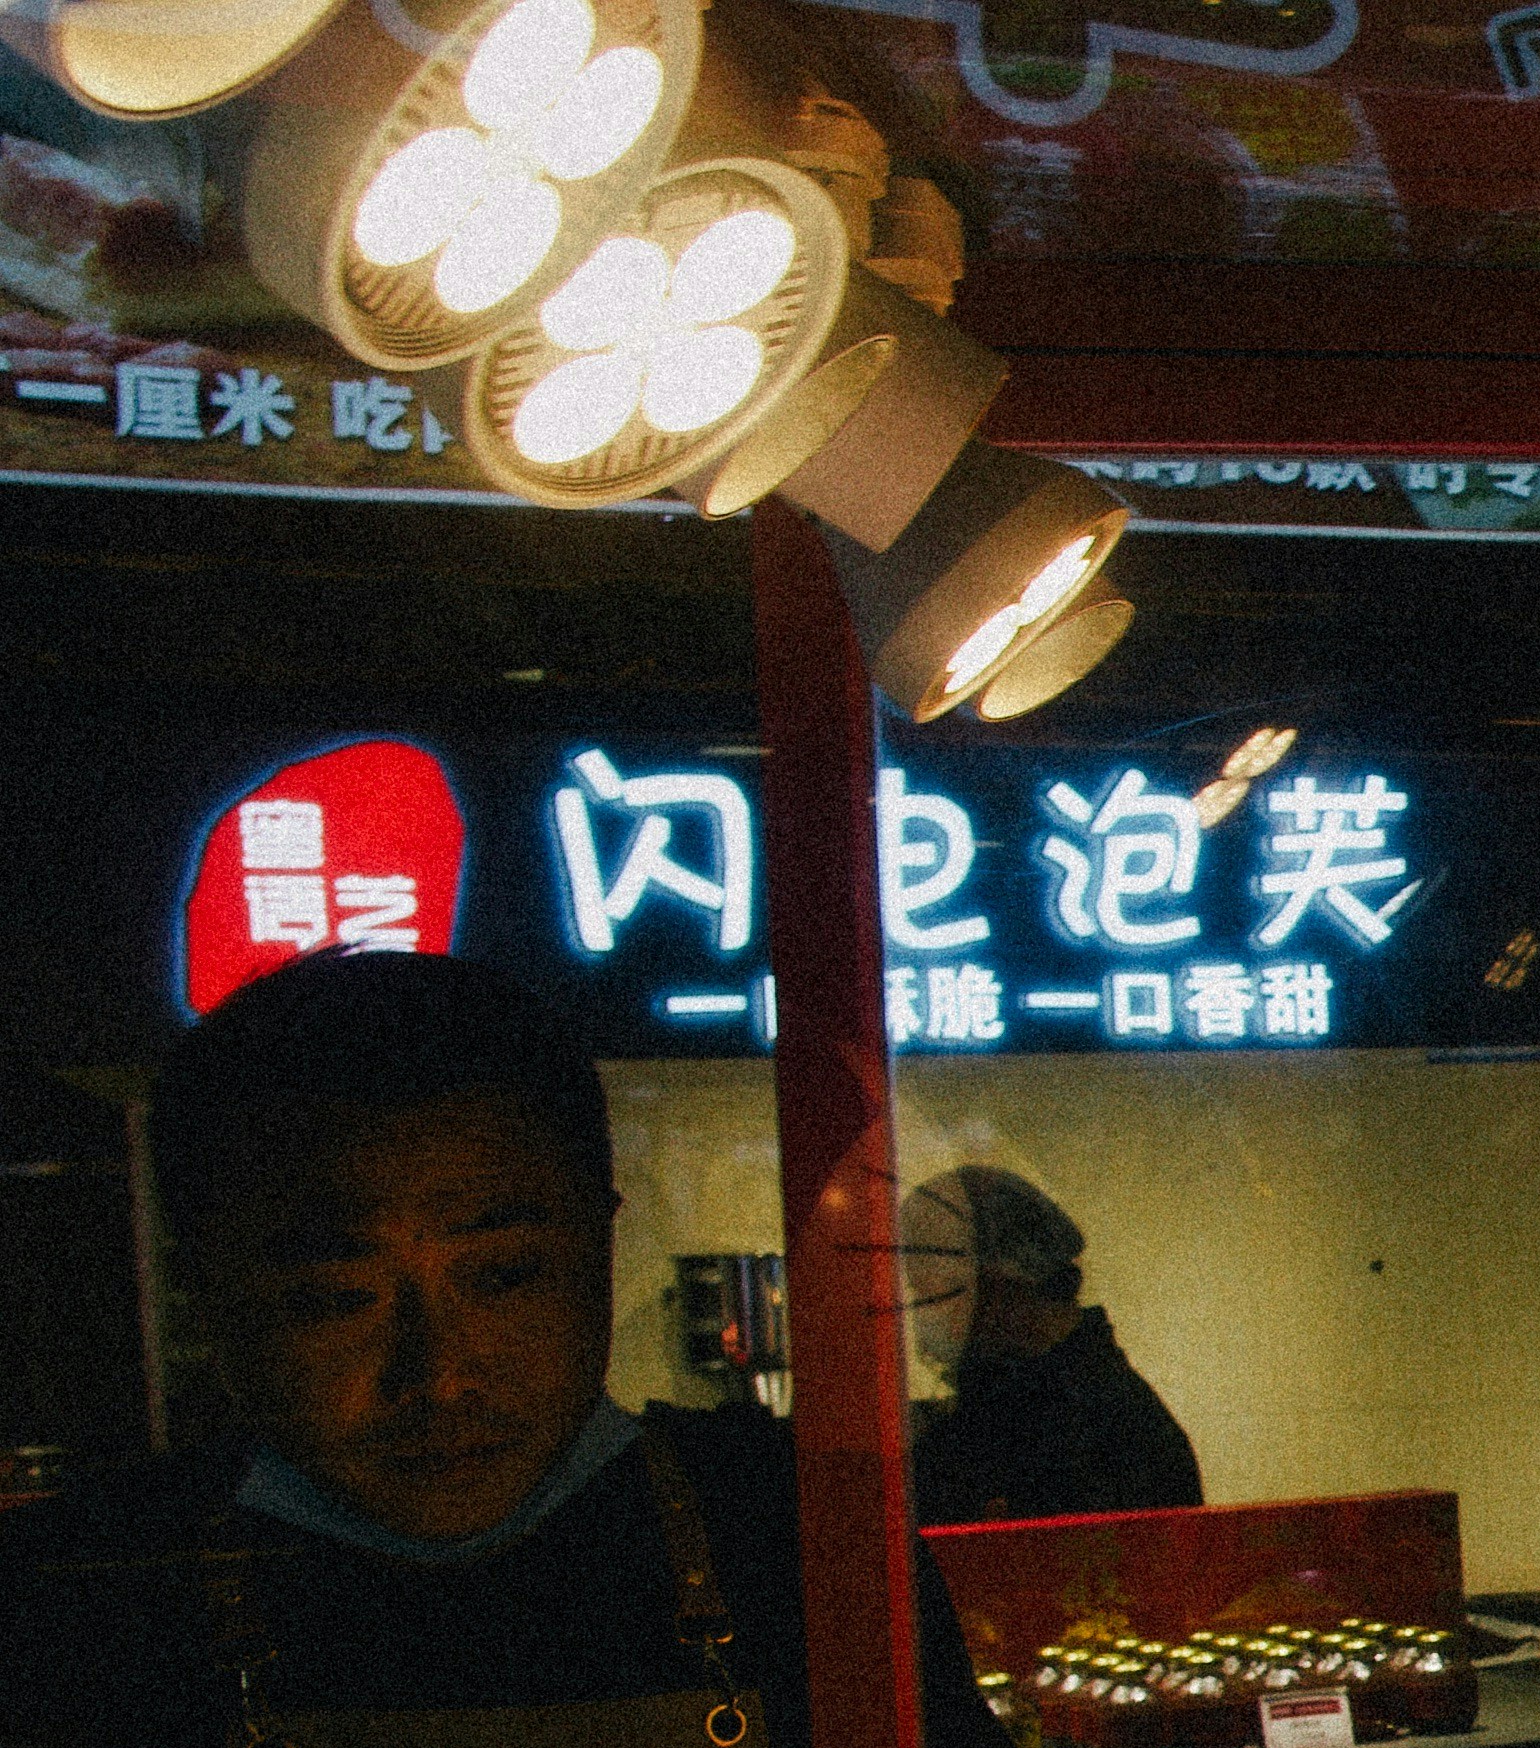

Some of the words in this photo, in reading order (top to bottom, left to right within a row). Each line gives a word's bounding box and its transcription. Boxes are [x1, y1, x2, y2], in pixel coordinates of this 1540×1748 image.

[15, 362, 295, 447] 一厘米
[332, 376, 454, 456] 吃
[334, 874, 420, 954] 艺
